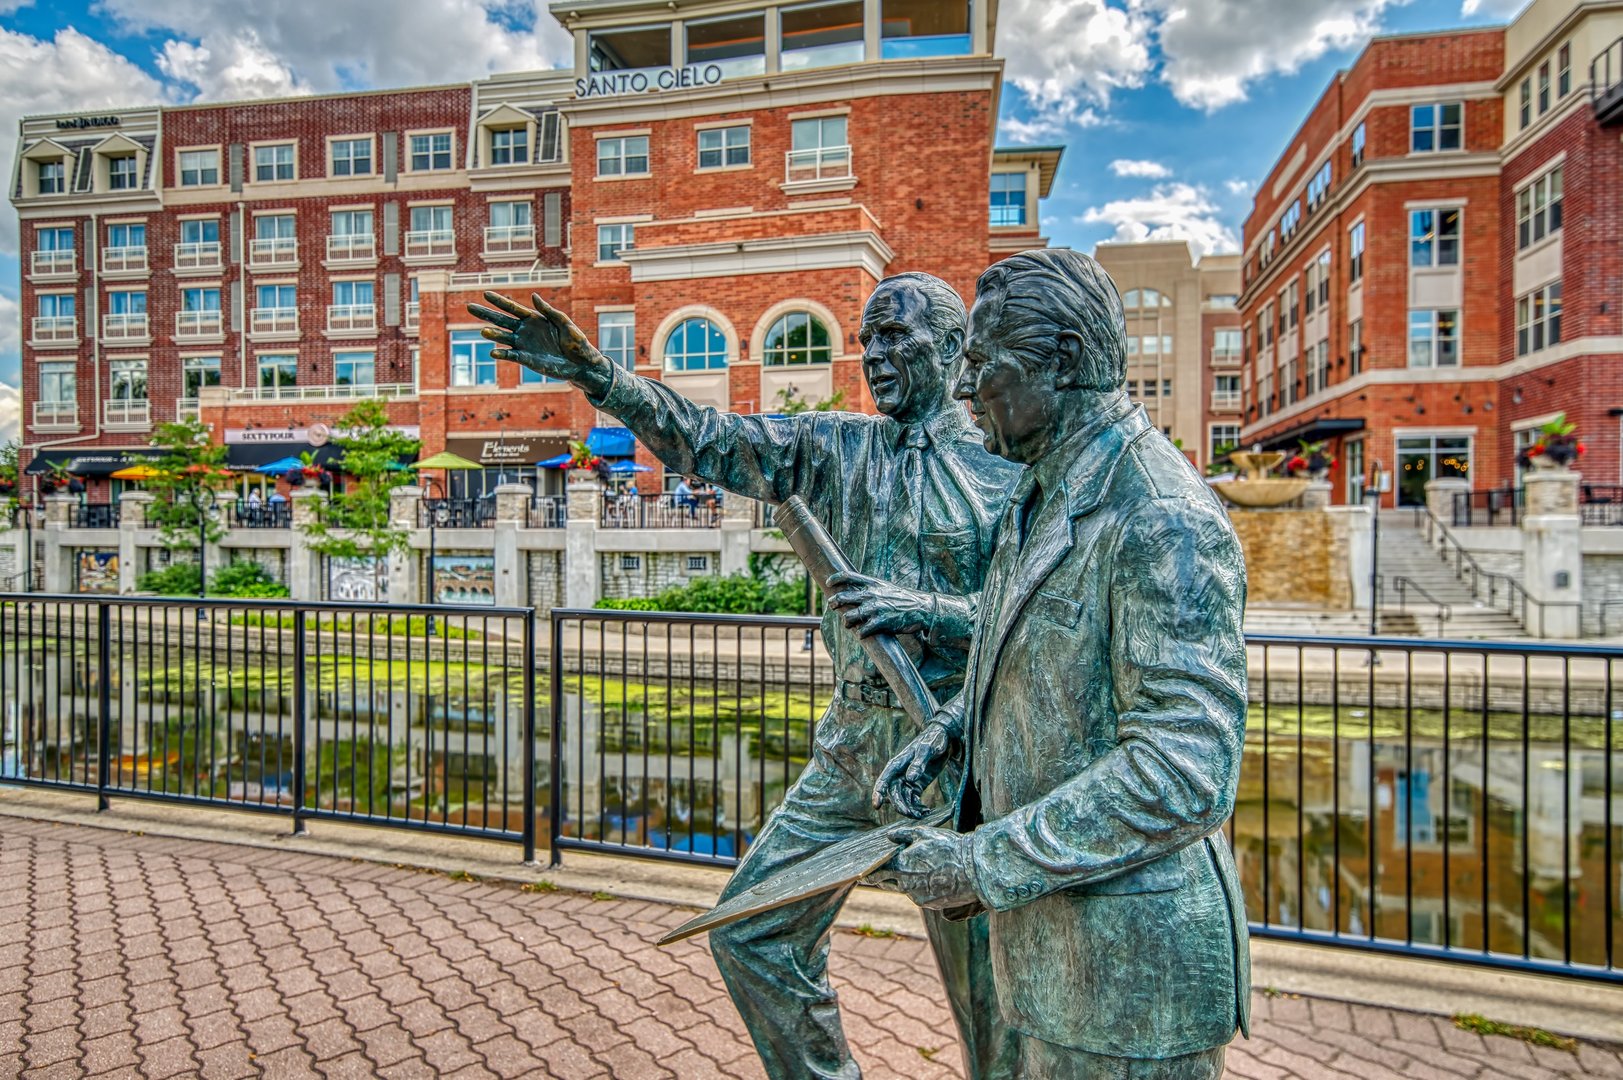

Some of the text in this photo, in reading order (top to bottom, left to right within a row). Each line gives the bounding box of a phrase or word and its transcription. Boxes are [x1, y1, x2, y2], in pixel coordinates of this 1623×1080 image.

[575, 64, 722, 97] SANTO CIELO
[481, 441, 530, 457] Elements
